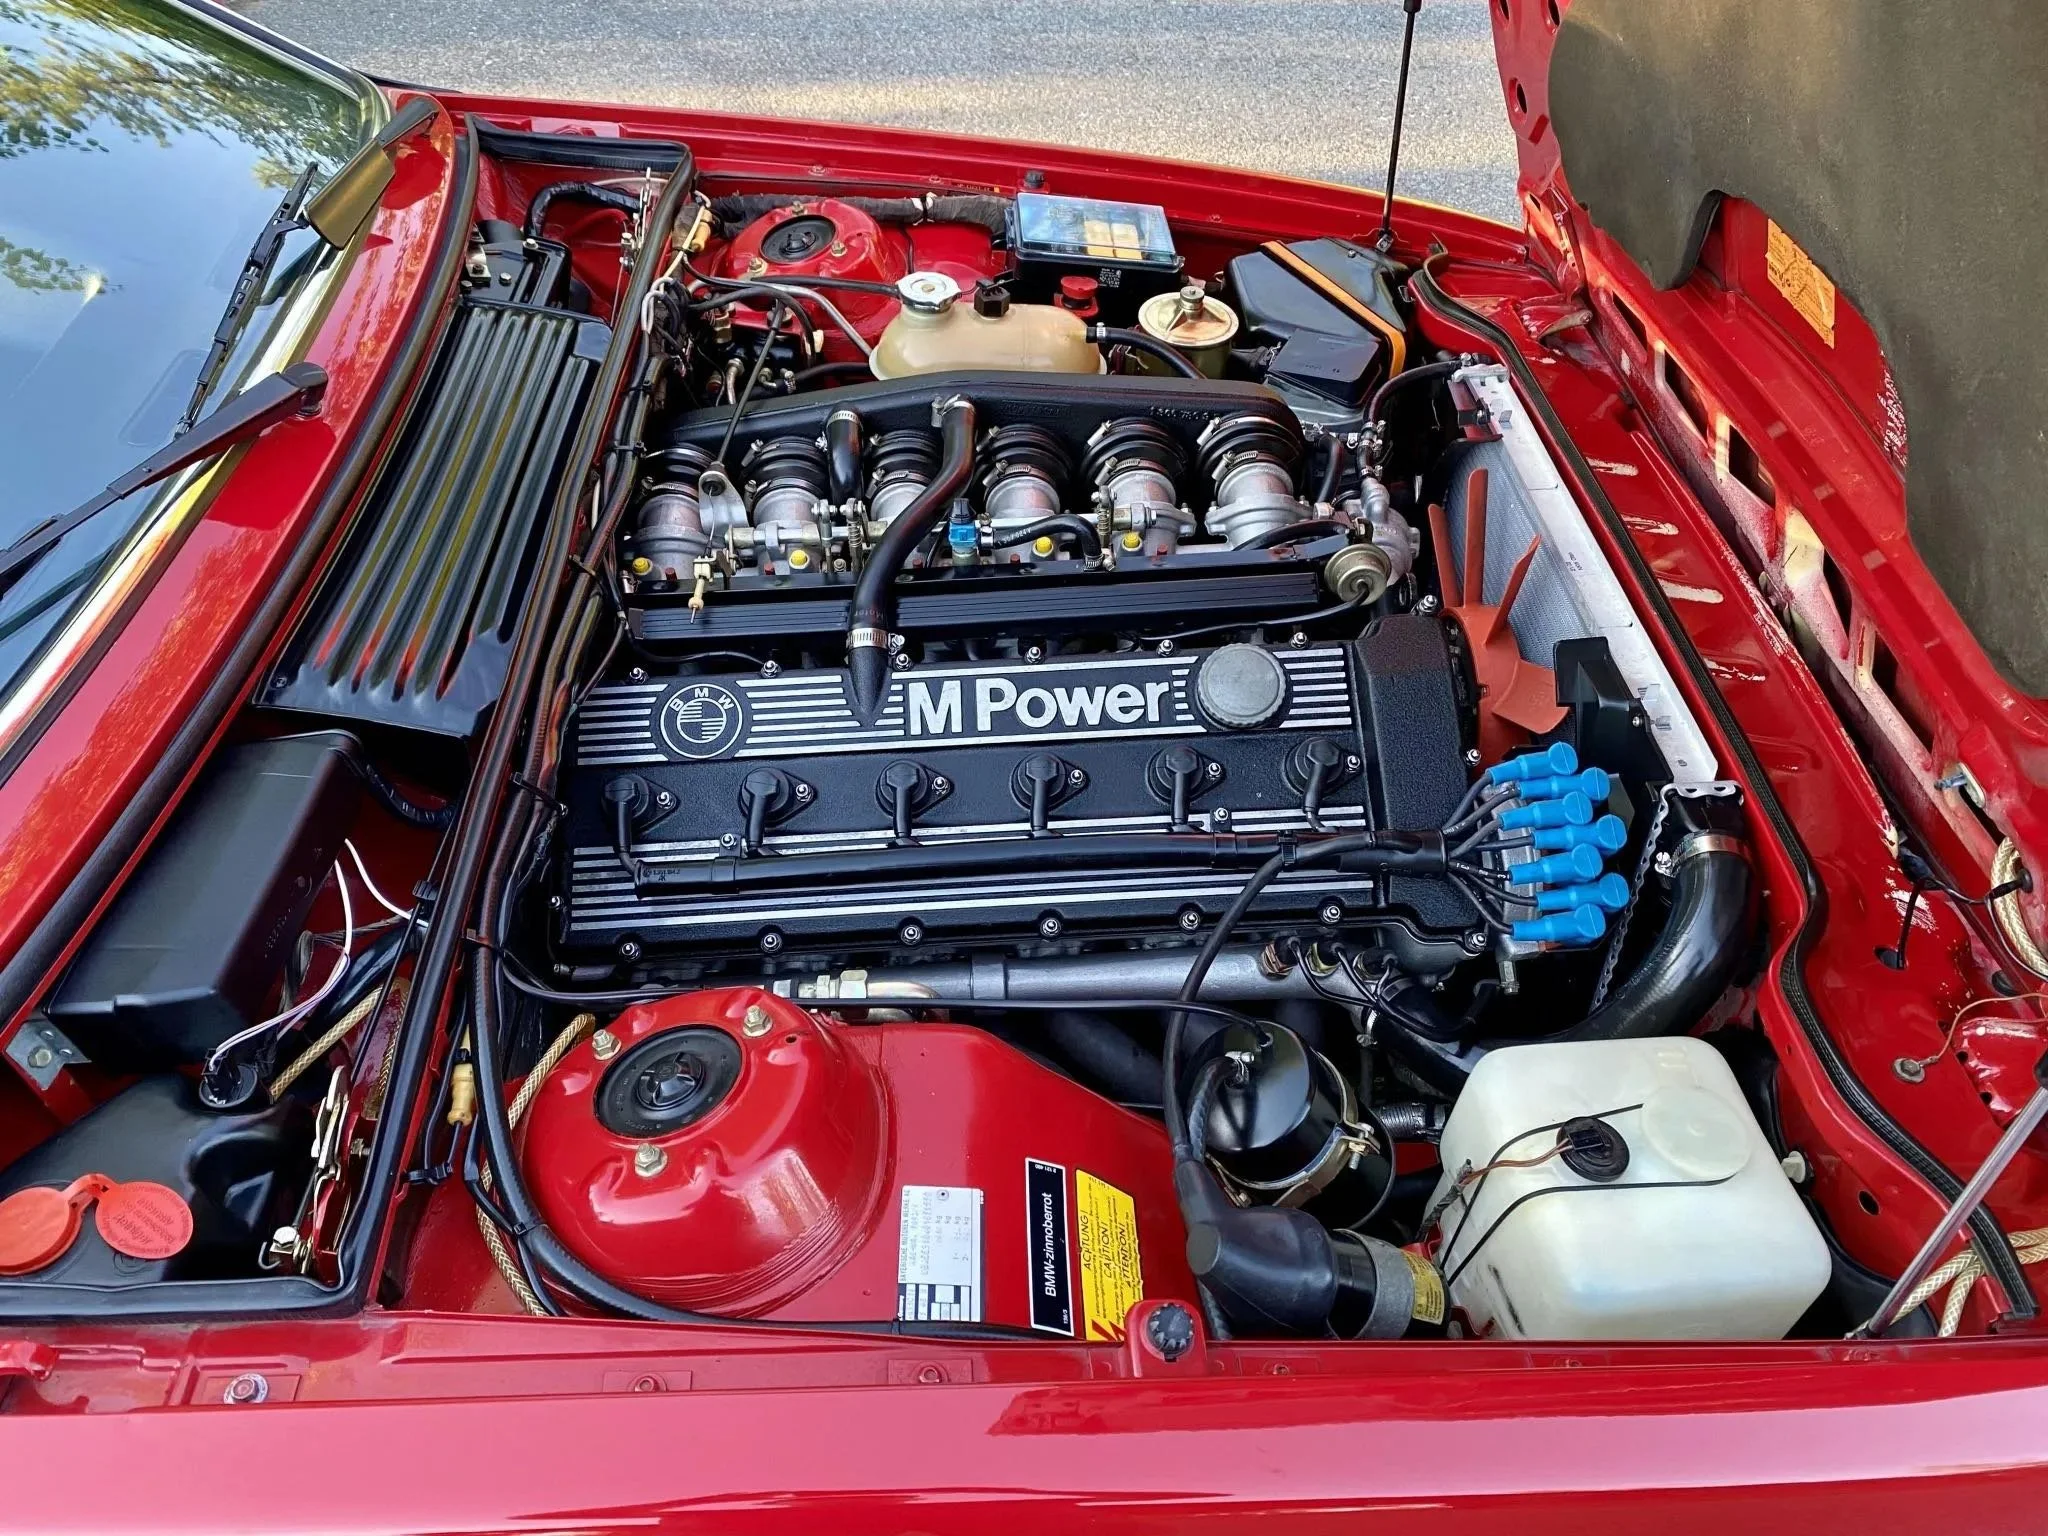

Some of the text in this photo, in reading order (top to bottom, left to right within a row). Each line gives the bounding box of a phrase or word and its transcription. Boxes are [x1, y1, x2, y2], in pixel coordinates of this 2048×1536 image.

[669, 687, 734, 712] BMW
[909, 677, 1169, 736] M Power
[1042, 1192, 1056, 1297] BMW-zinnoberrot
[1119, 1222, 1131, 1287] ATTENTON!
